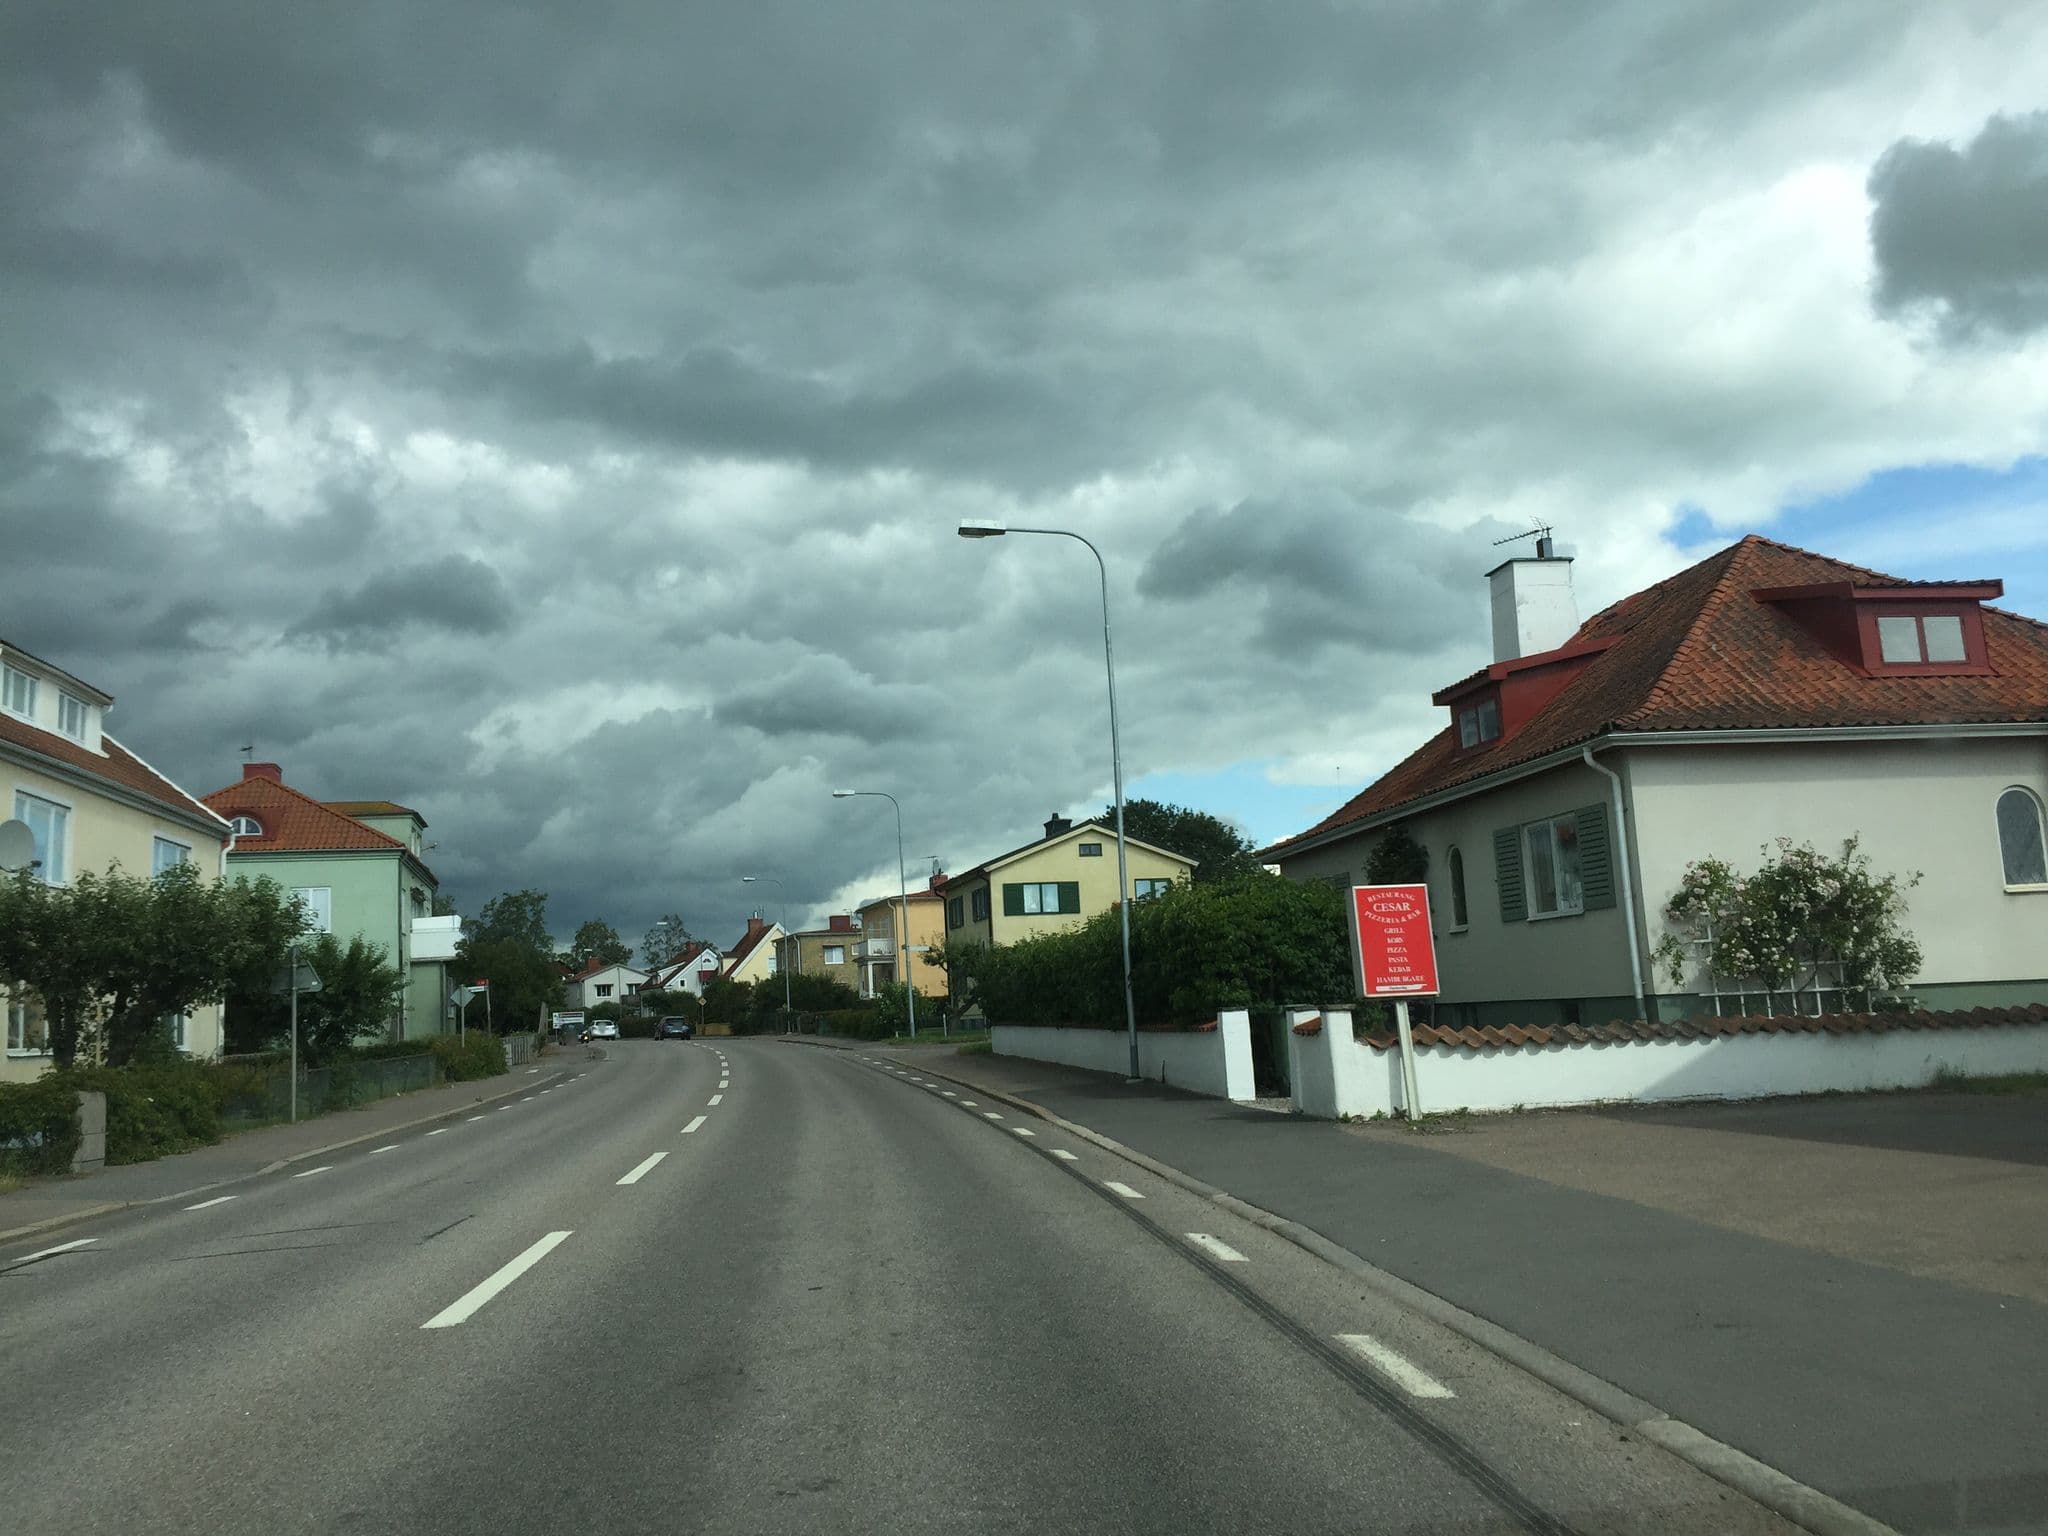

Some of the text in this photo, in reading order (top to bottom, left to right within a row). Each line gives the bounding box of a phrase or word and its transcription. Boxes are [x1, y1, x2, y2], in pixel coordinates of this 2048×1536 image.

[1367, 892, 1415, 903] RESTAURANG
[1372, 902, 1411, 912] CESAR
[1364, 910, 1400, 924] PIZZERIA
[1407, 909, 1421, 920] BAR
